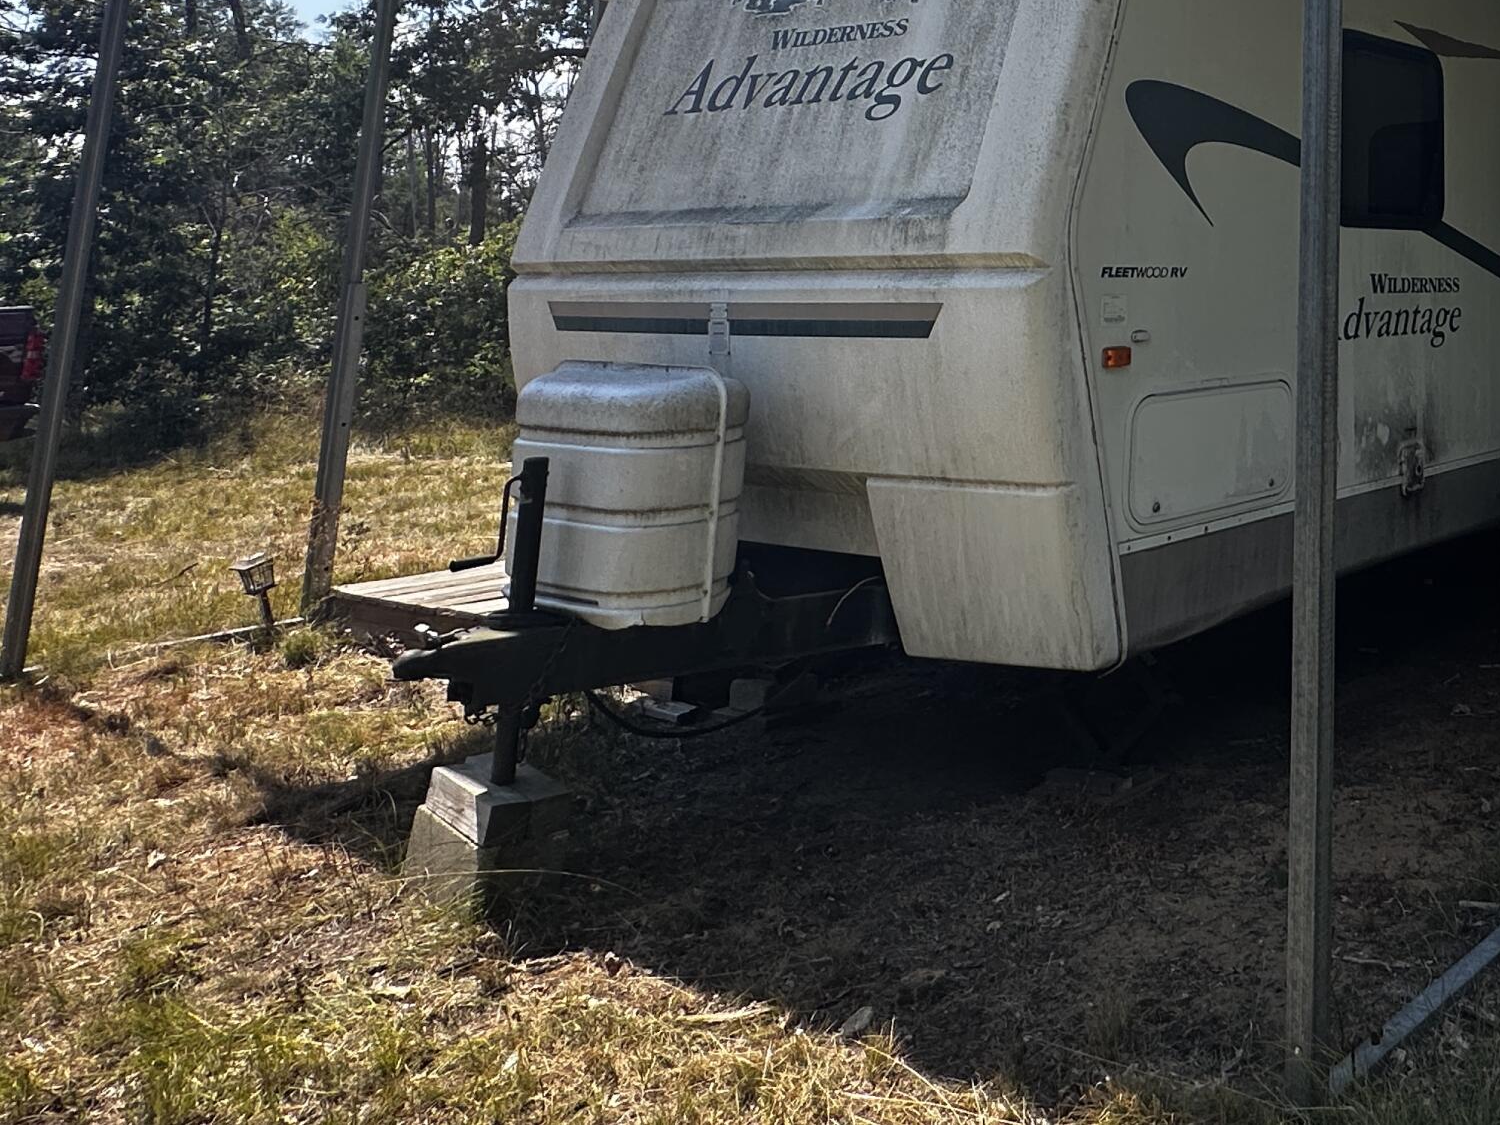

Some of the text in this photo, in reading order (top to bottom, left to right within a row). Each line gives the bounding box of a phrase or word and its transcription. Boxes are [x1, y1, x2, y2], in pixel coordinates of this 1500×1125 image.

[770, 18, 910, 50] WILDERNESS
[663, 52, 954, 122] Advantage
[1101, 266, 1188, 279] FLEETWOOD RV
[1369, 273, 1460, 294] WILDERNESS
[1338, 296, 1462, 348] dvantage
